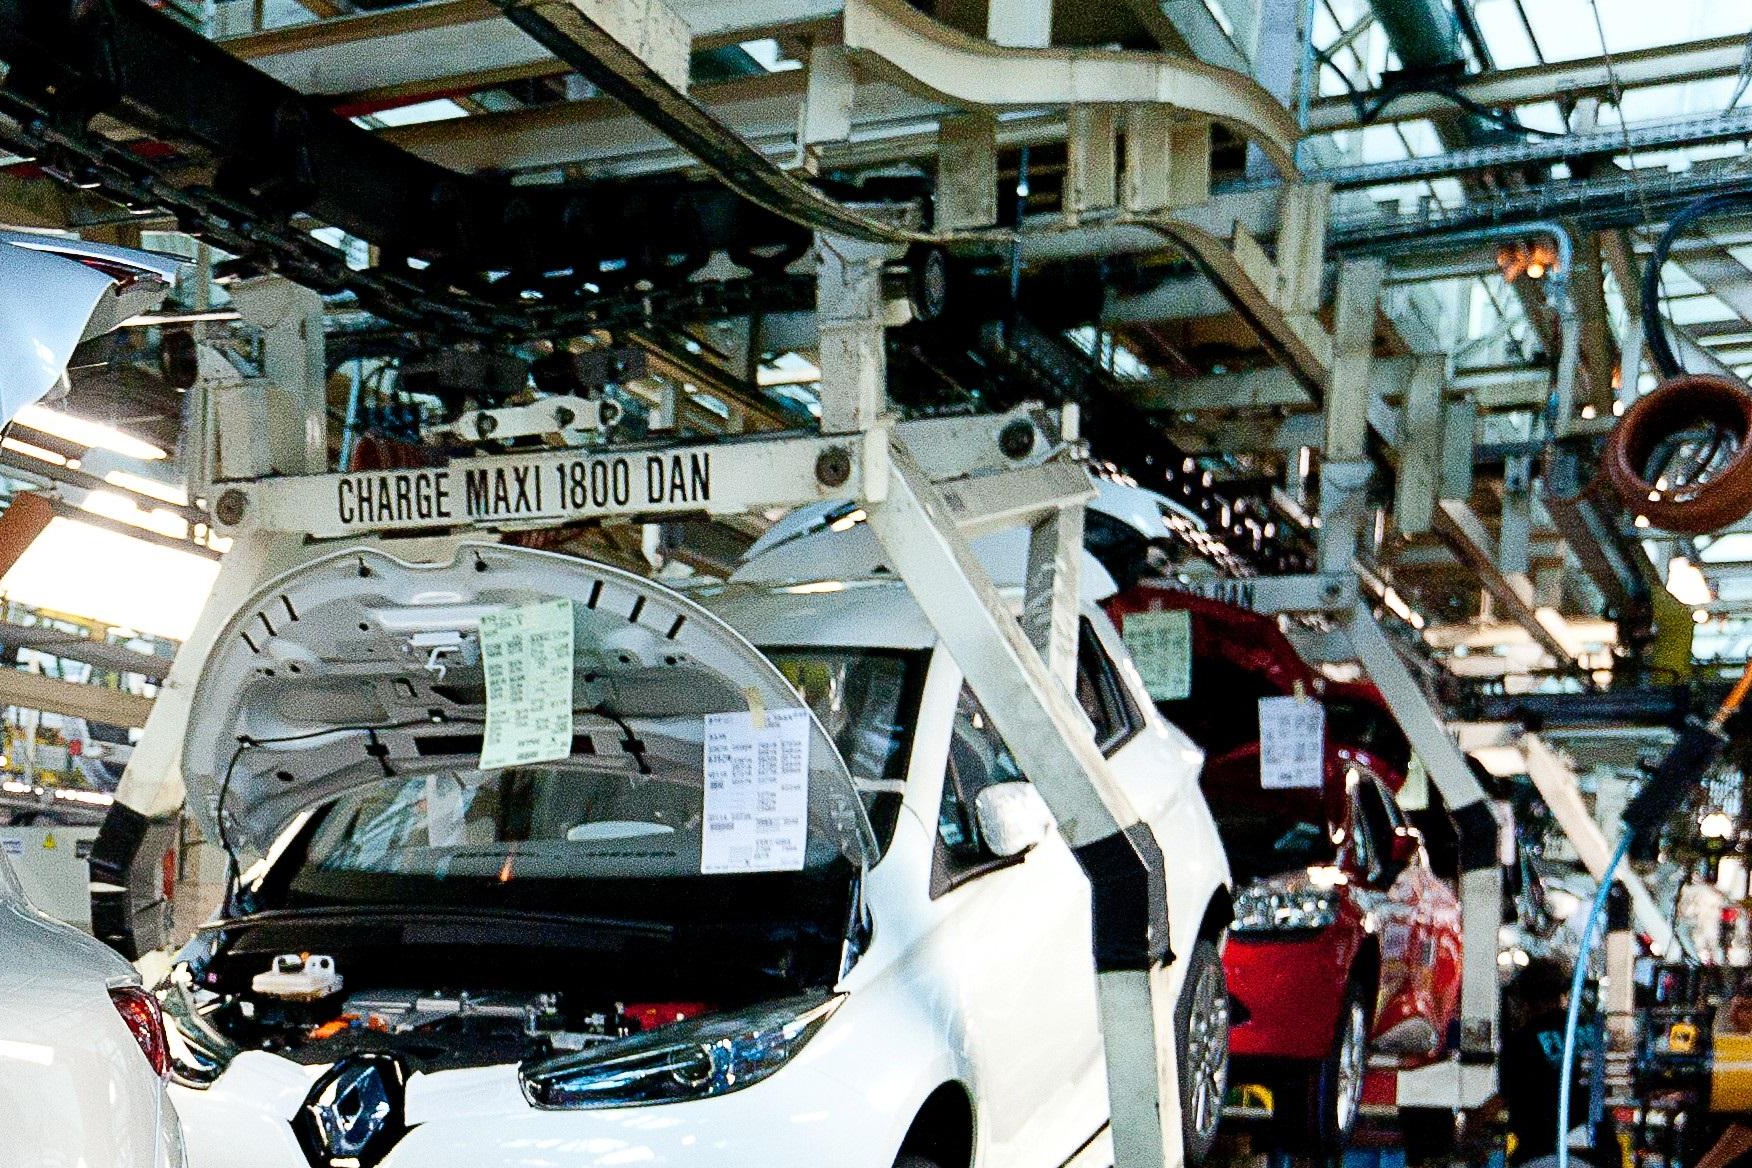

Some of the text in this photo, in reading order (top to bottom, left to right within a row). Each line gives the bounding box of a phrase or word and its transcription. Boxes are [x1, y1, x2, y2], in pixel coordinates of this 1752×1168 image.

[338, 452, 711, 525] CHARGE MAXI 1800 DAN
